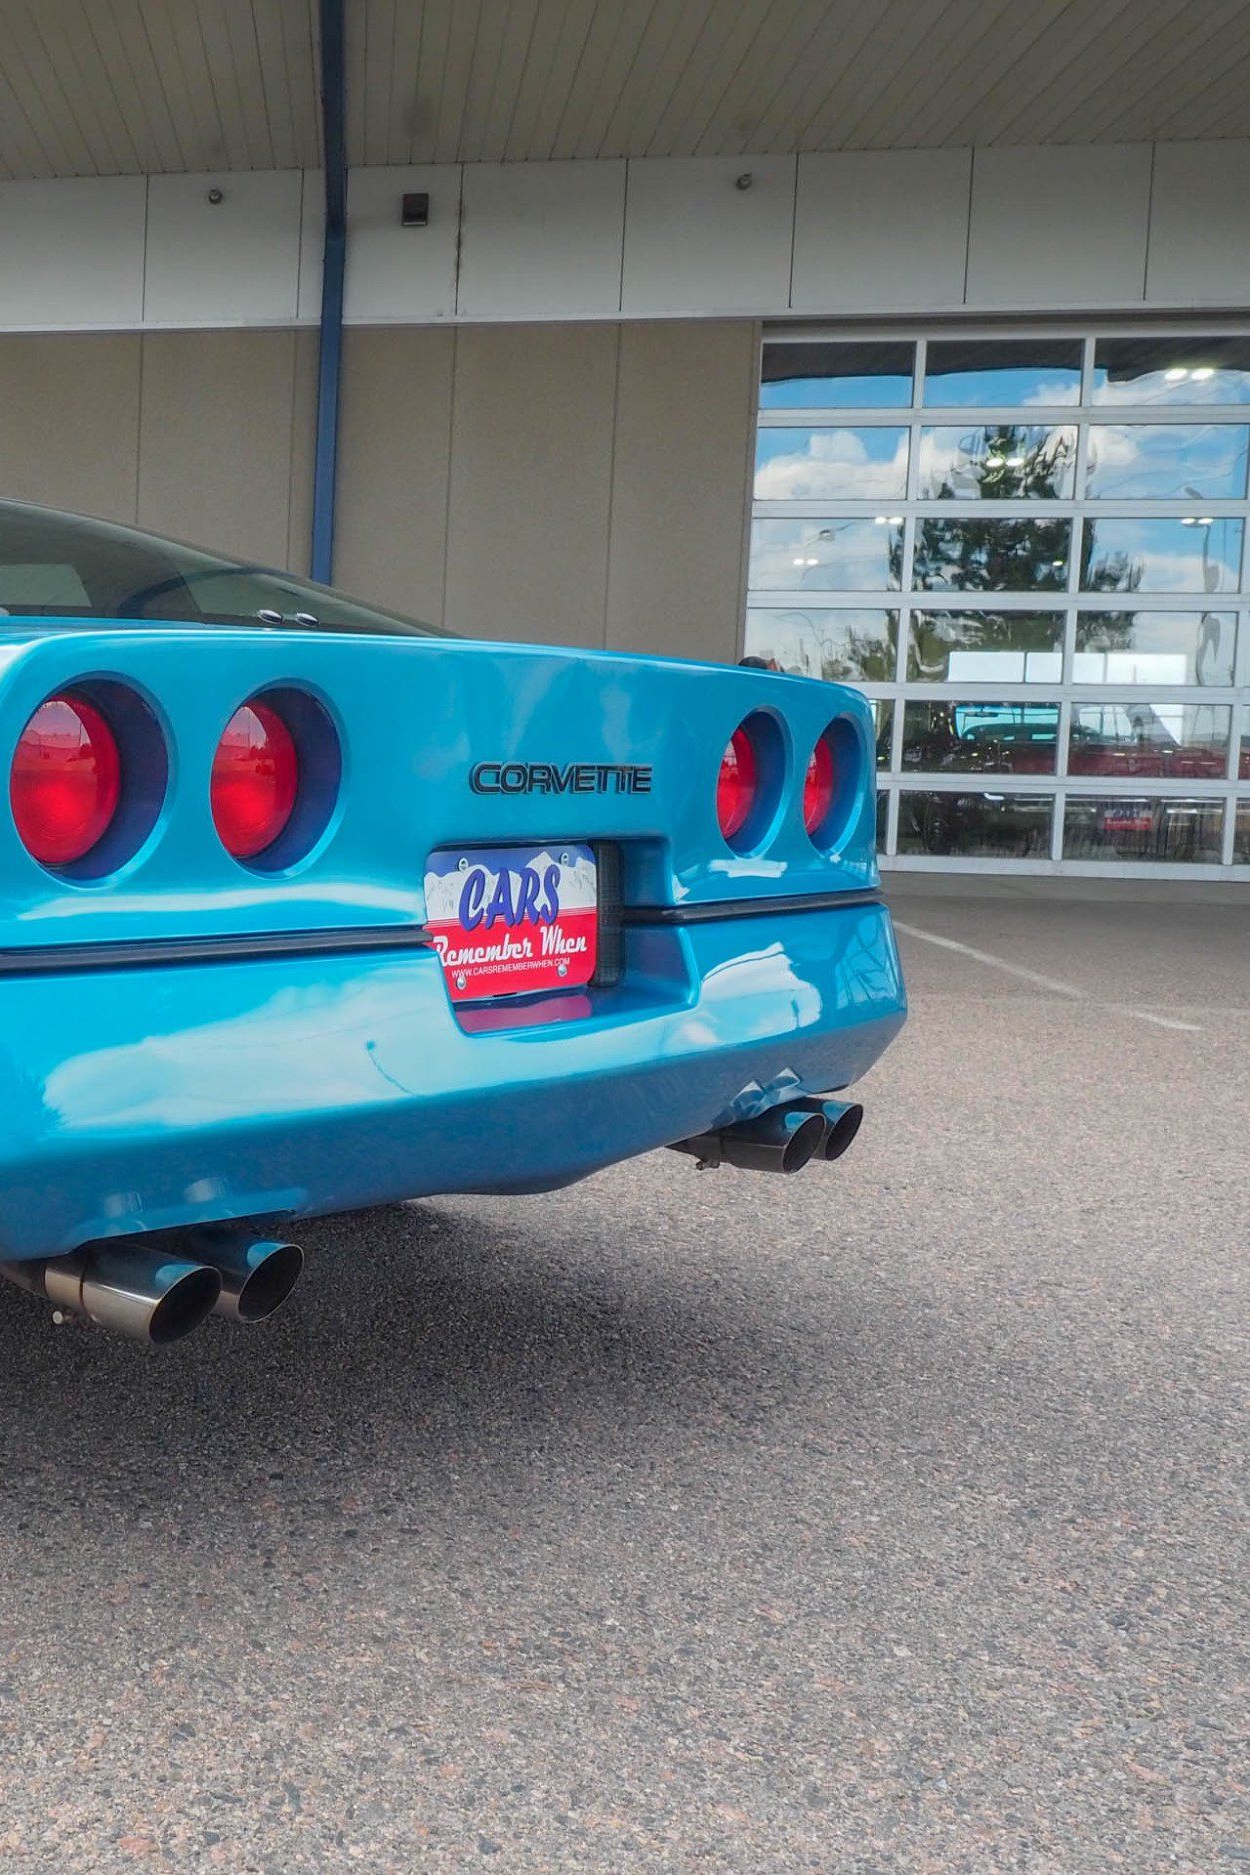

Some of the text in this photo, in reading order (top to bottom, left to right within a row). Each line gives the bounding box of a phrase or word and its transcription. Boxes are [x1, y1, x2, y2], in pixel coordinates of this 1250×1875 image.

[470, 761, 652, 793] CORVETTE
[459, 865, 561, 931] CARS
[433, 925, 587, 967] Remember When
[452, 957, 570, 978] WWW.CARSREMEMBERWHEN.COM
